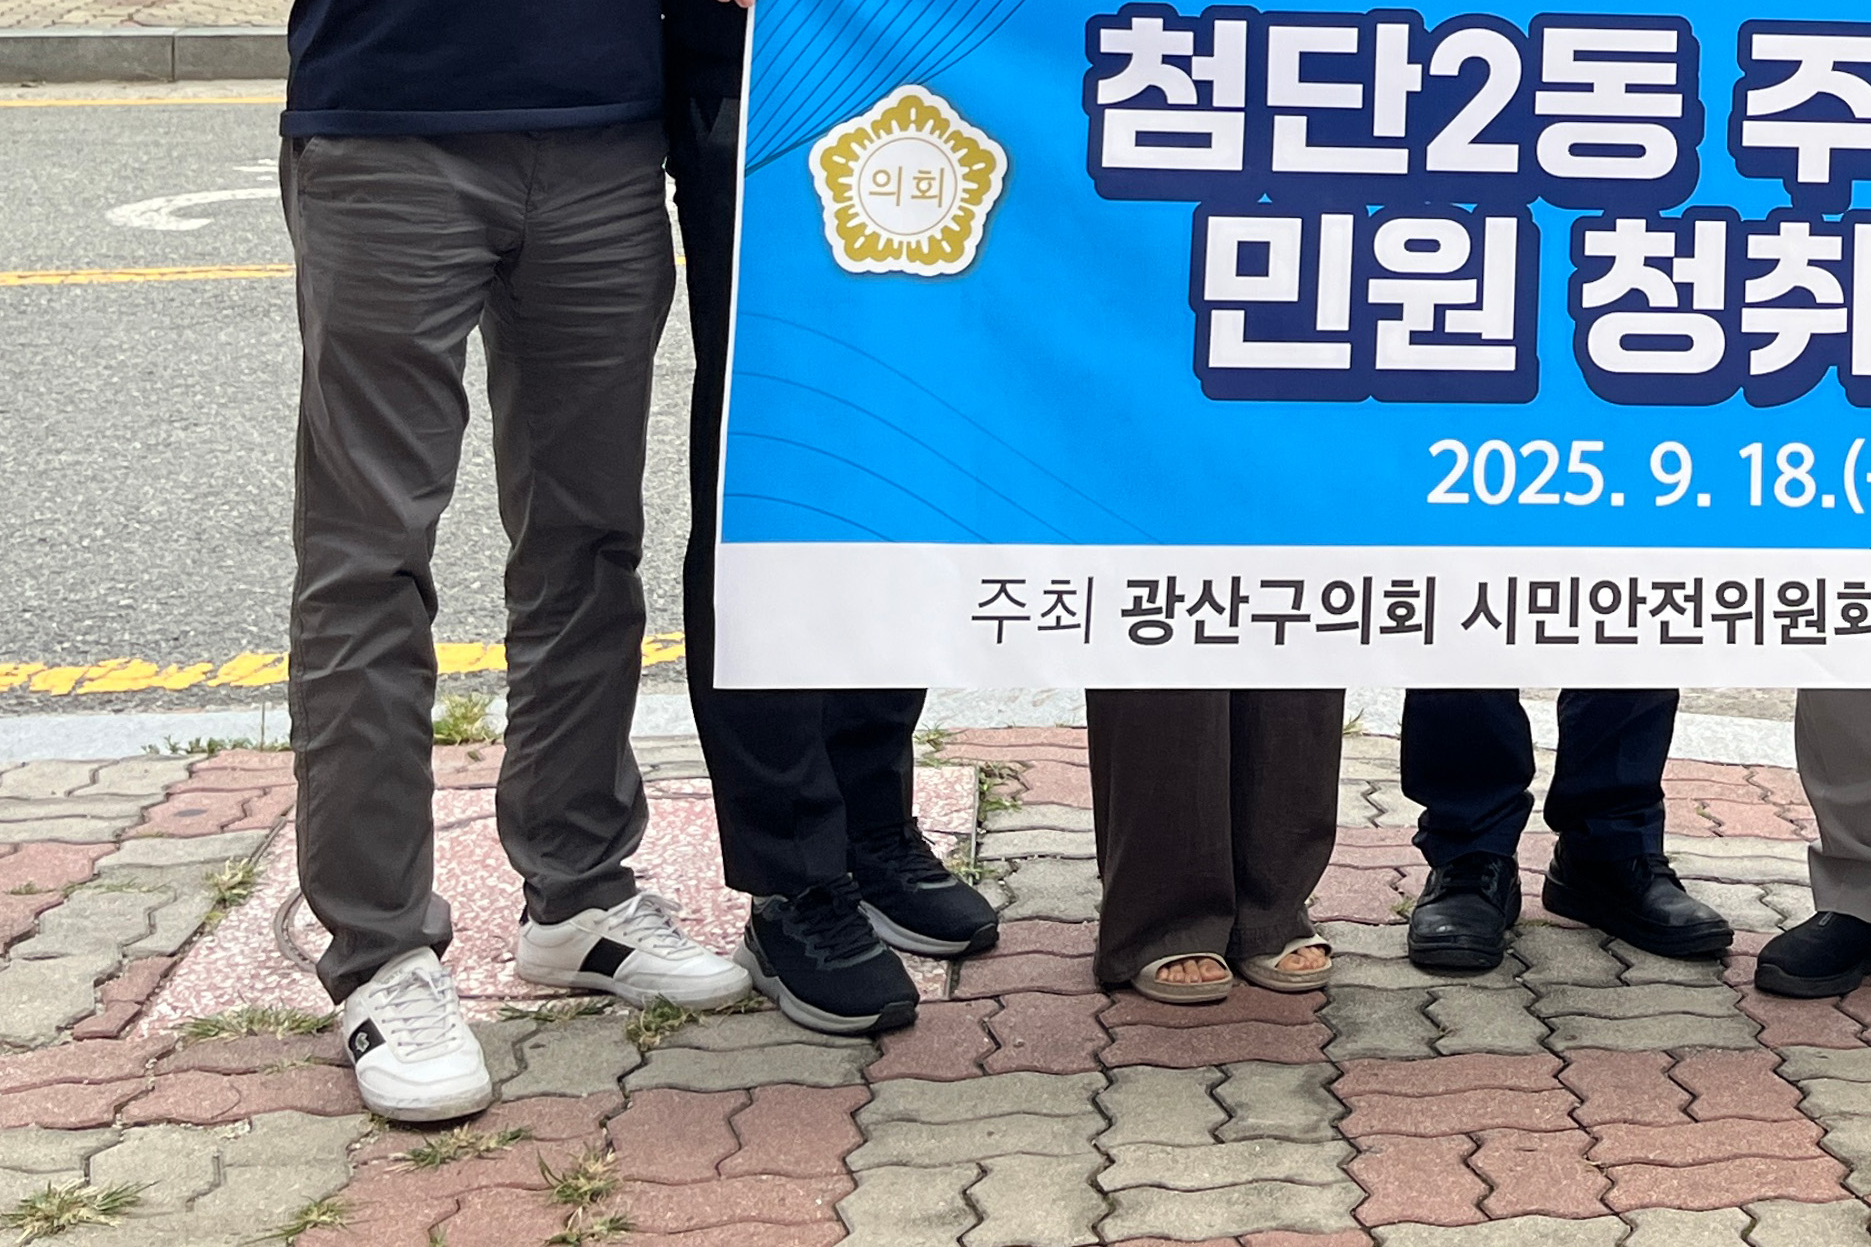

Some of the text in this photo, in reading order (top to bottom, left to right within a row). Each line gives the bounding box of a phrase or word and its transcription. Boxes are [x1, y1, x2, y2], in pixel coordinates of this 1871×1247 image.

[1097, 17, 1683, 180] 첨단2동
[868, 164, 945, 208] 의회
[1203, 214, 1518, 371] 민원
[1427, 439, 1624, 508] 2025.
[1649, 441, 1711, 508] 9.
[971, 575, 1095, 645] 주최
[1120, 575, 1434, 646] 광산구의회
